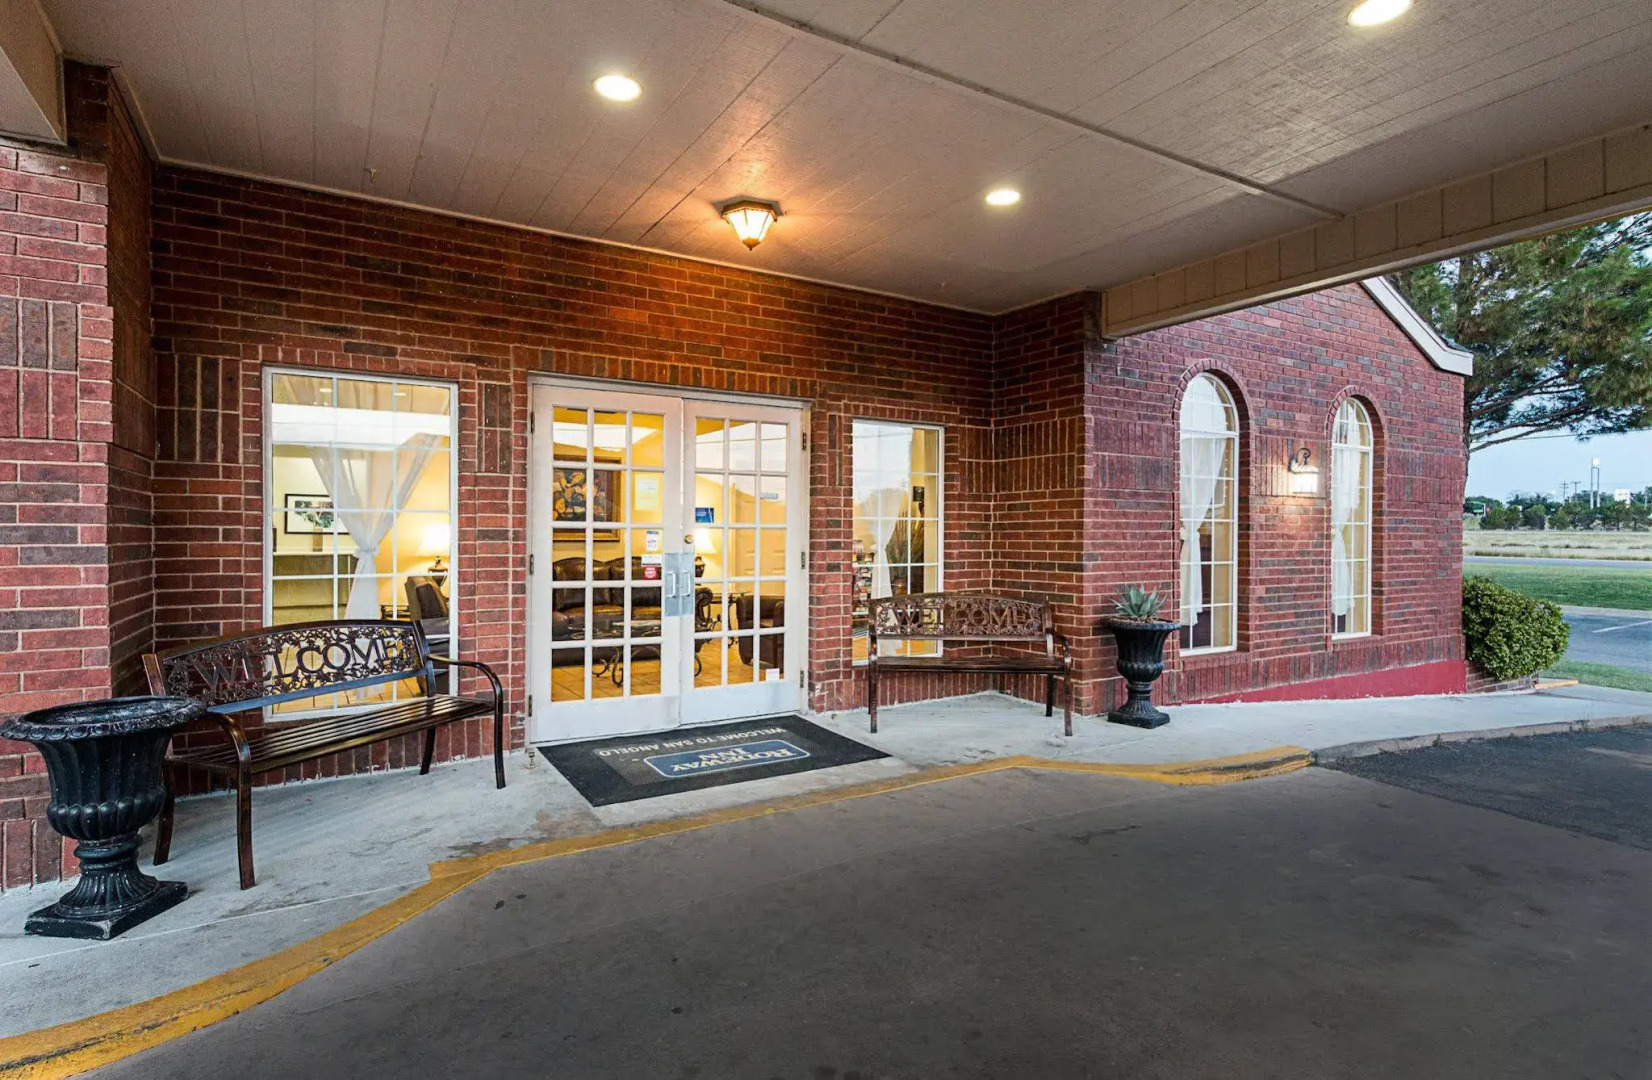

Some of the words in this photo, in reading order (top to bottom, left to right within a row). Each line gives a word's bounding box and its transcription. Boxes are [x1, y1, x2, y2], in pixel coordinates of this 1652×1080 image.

[892, 606, 1027, 627] WELCOME
[194, 637, 399, 691] WELCOME
[696, 735, 714, 744] TO
[717, 727, 787, 742] WELCOME
[598, 743, 660, 757] ANGELO
[663, 739, 694, 749] SAN
[671, 749, 797, 772] RODEWAY
[698, 747, 749, 761] INN
